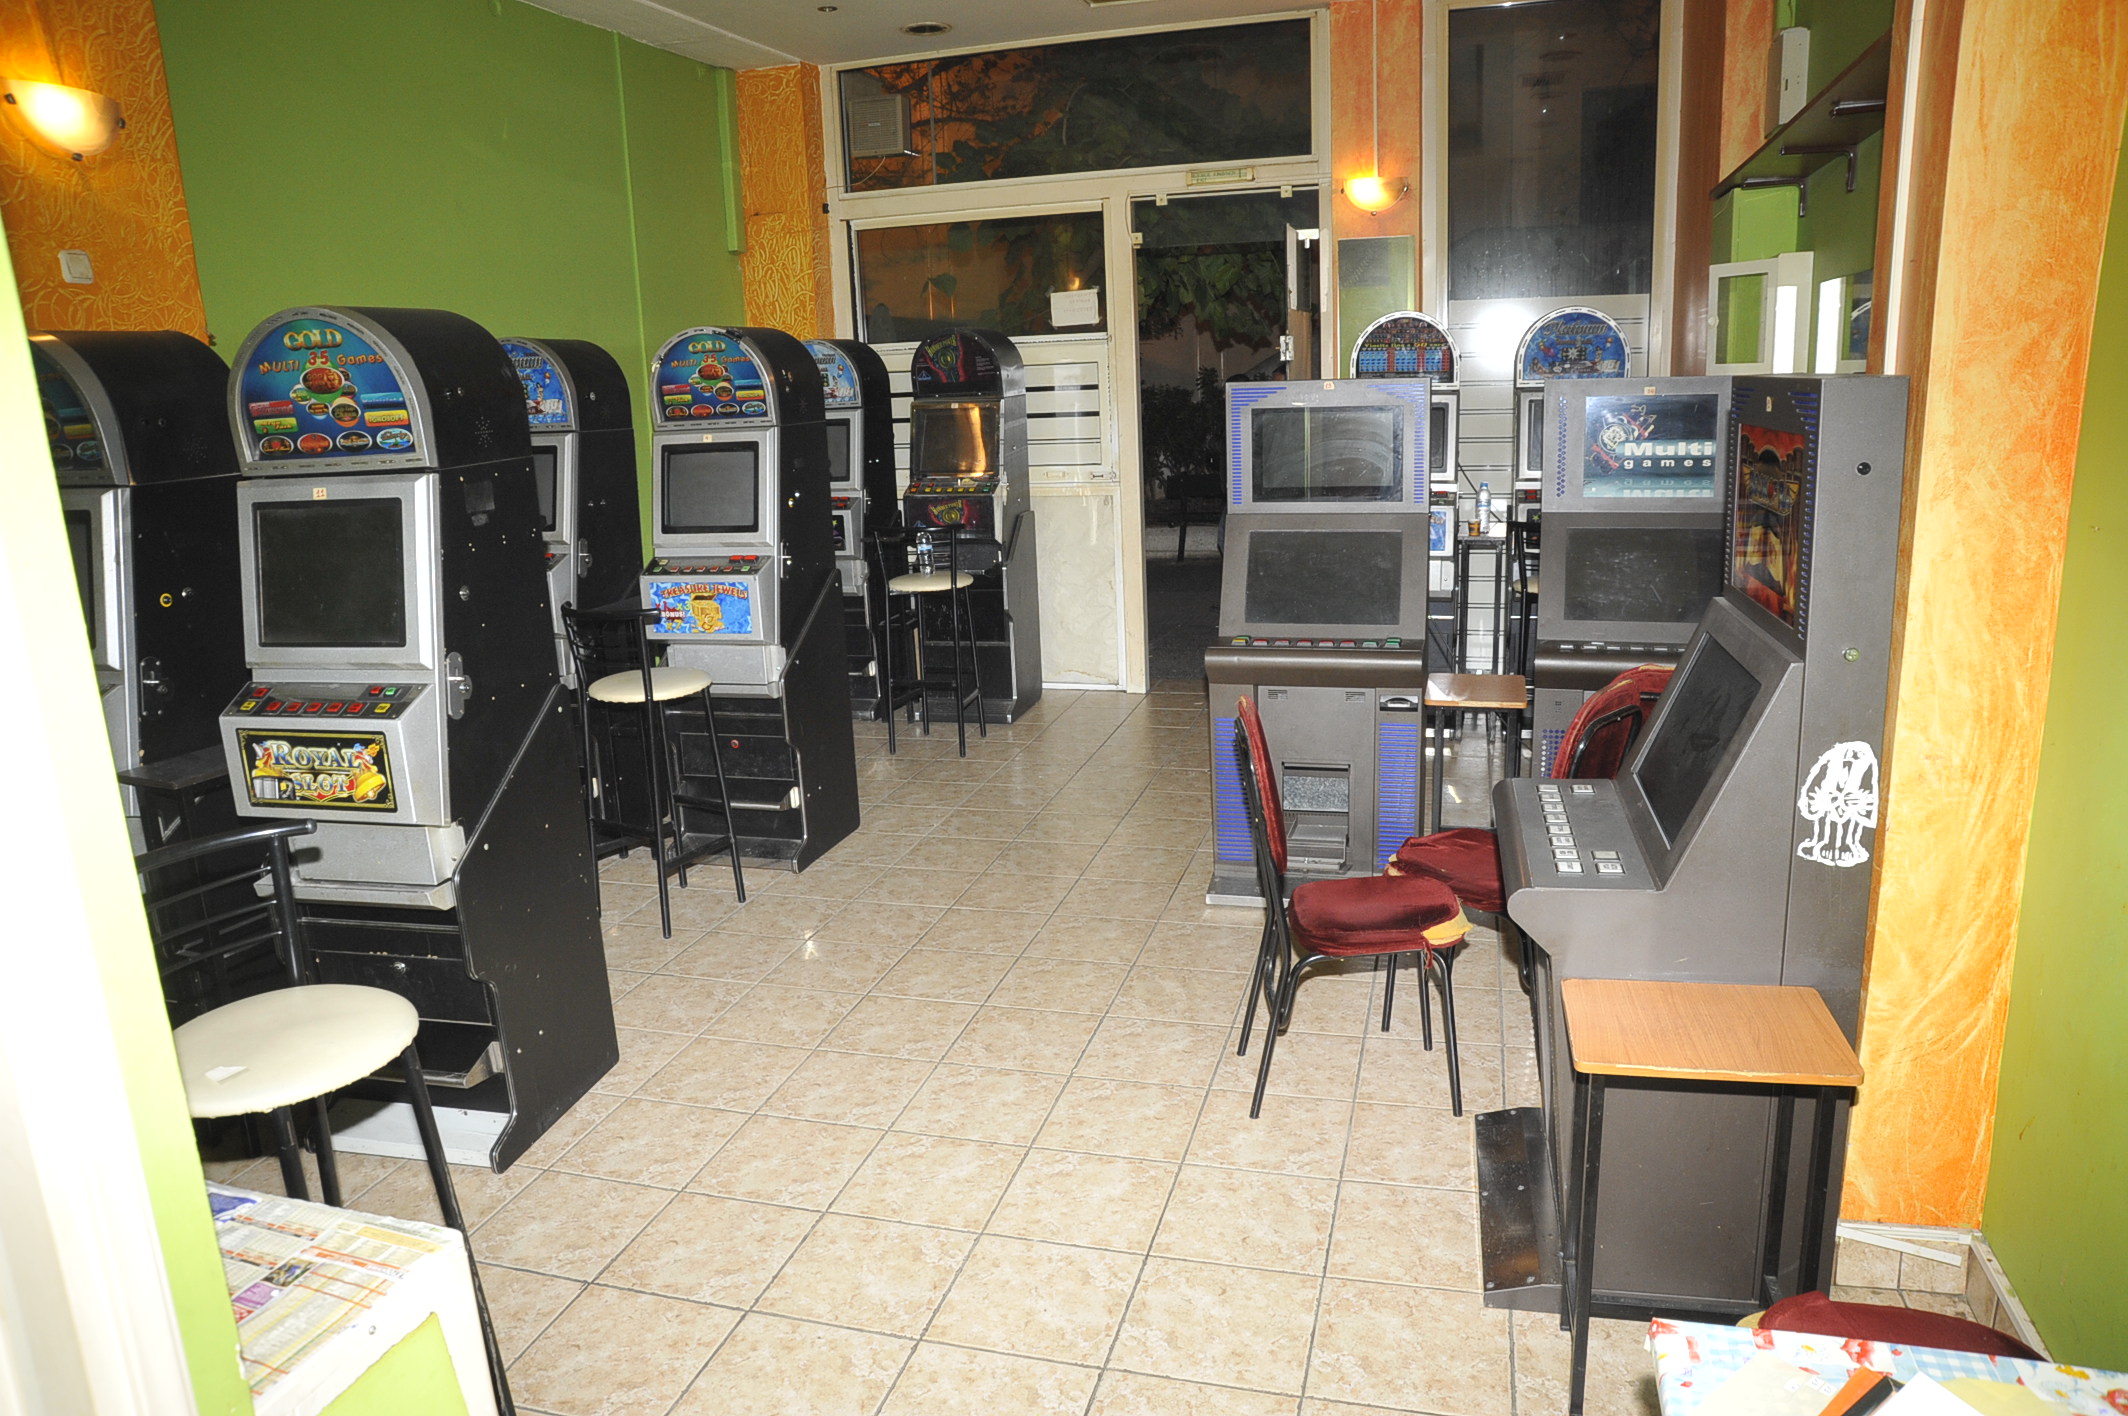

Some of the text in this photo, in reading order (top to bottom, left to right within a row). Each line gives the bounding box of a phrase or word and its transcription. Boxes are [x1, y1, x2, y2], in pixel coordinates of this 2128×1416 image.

[282, 328, 343, 351] GOLD
[688, 340, 726, 354] GOLD
[259, 350, 384, 375] MULTI 35 Games
[670, 353, 752, 369] MULTI 35 Games
[1623, 441, 1714, 456] Multi
[1623, 459, 1712, 470] games
[660, 583, 748, 599] TREASURE JEWELS
[266, 739, 362, 770] ROYAL
[291, 773, 351, 795] SLOT
